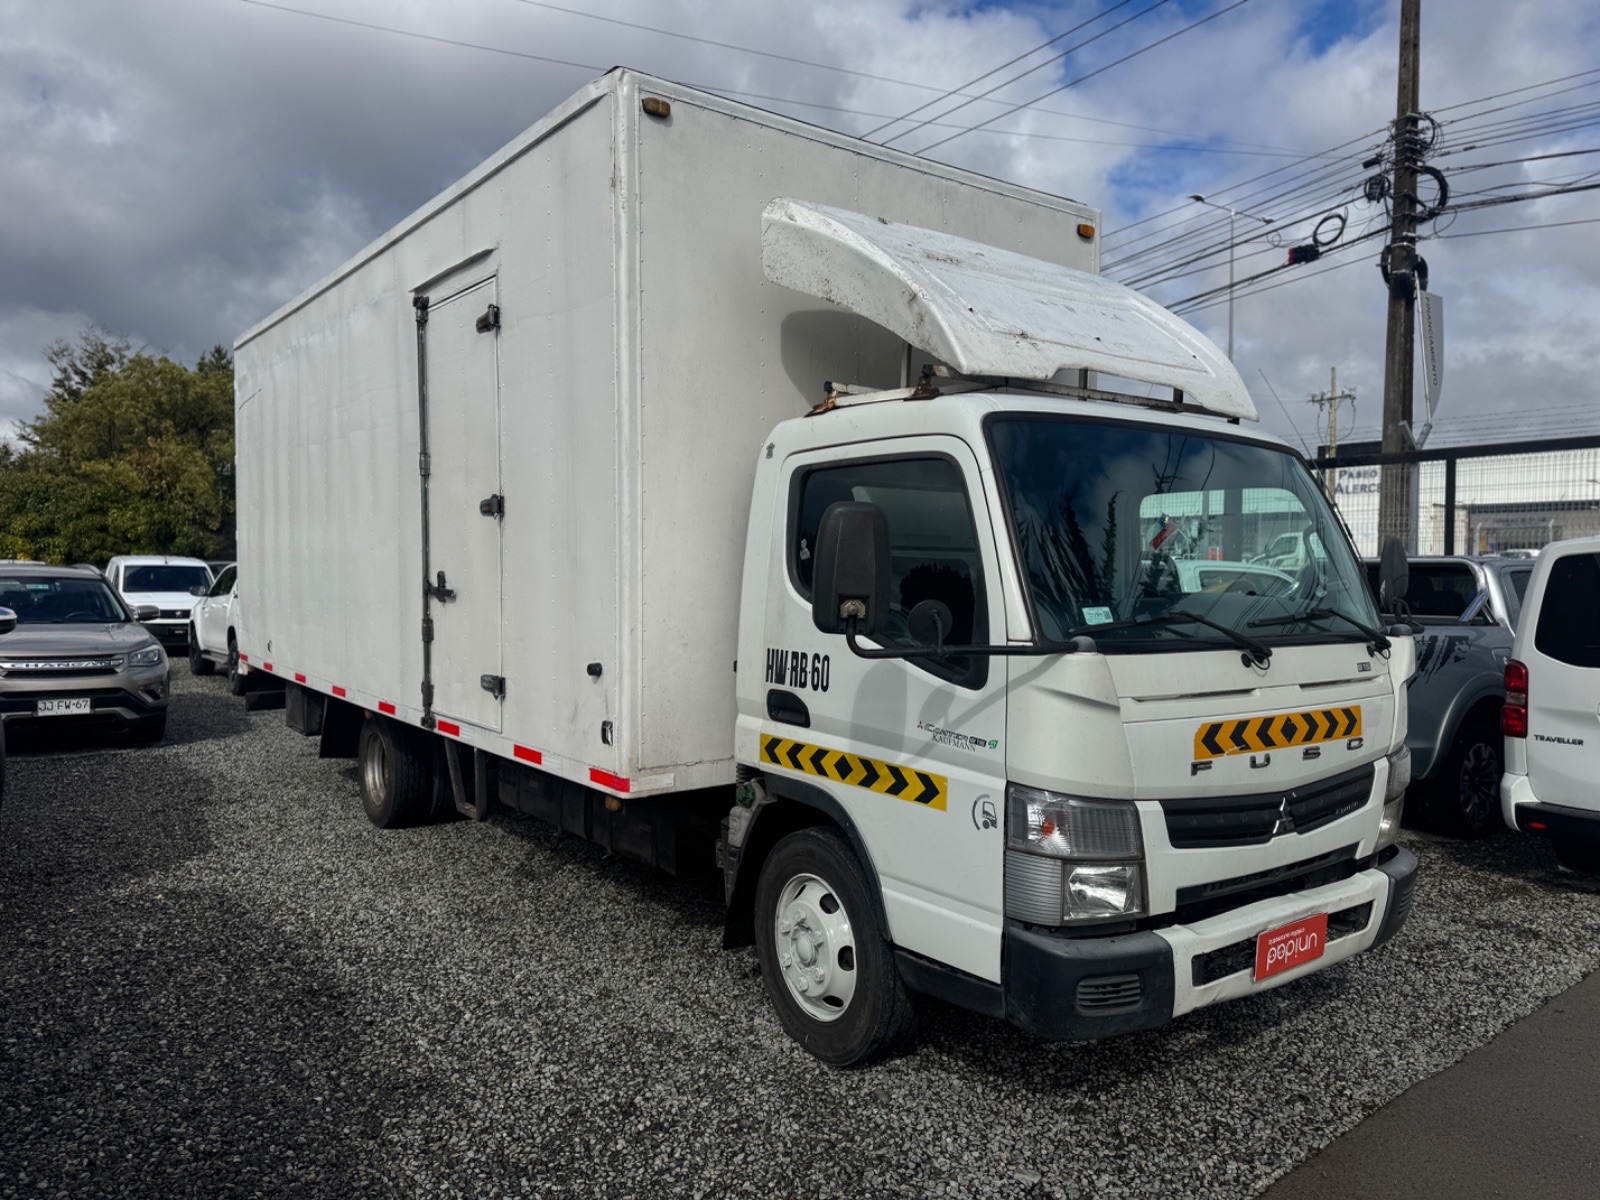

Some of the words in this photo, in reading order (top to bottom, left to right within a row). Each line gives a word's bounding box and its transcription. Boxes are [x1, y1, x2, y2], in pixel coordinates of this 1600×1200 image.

[1425, 296, 1438, 386] FINANCIAMIENTO
[1339, 470, 1378, 480] PASEO
[932, 733, 976, 752] KAUFMANN
[1534, 734, 1584, 746] TRAVELLER
[1190, 737, 1364, 777] FUSO
[1266, 932, 1318, 971] unidad
